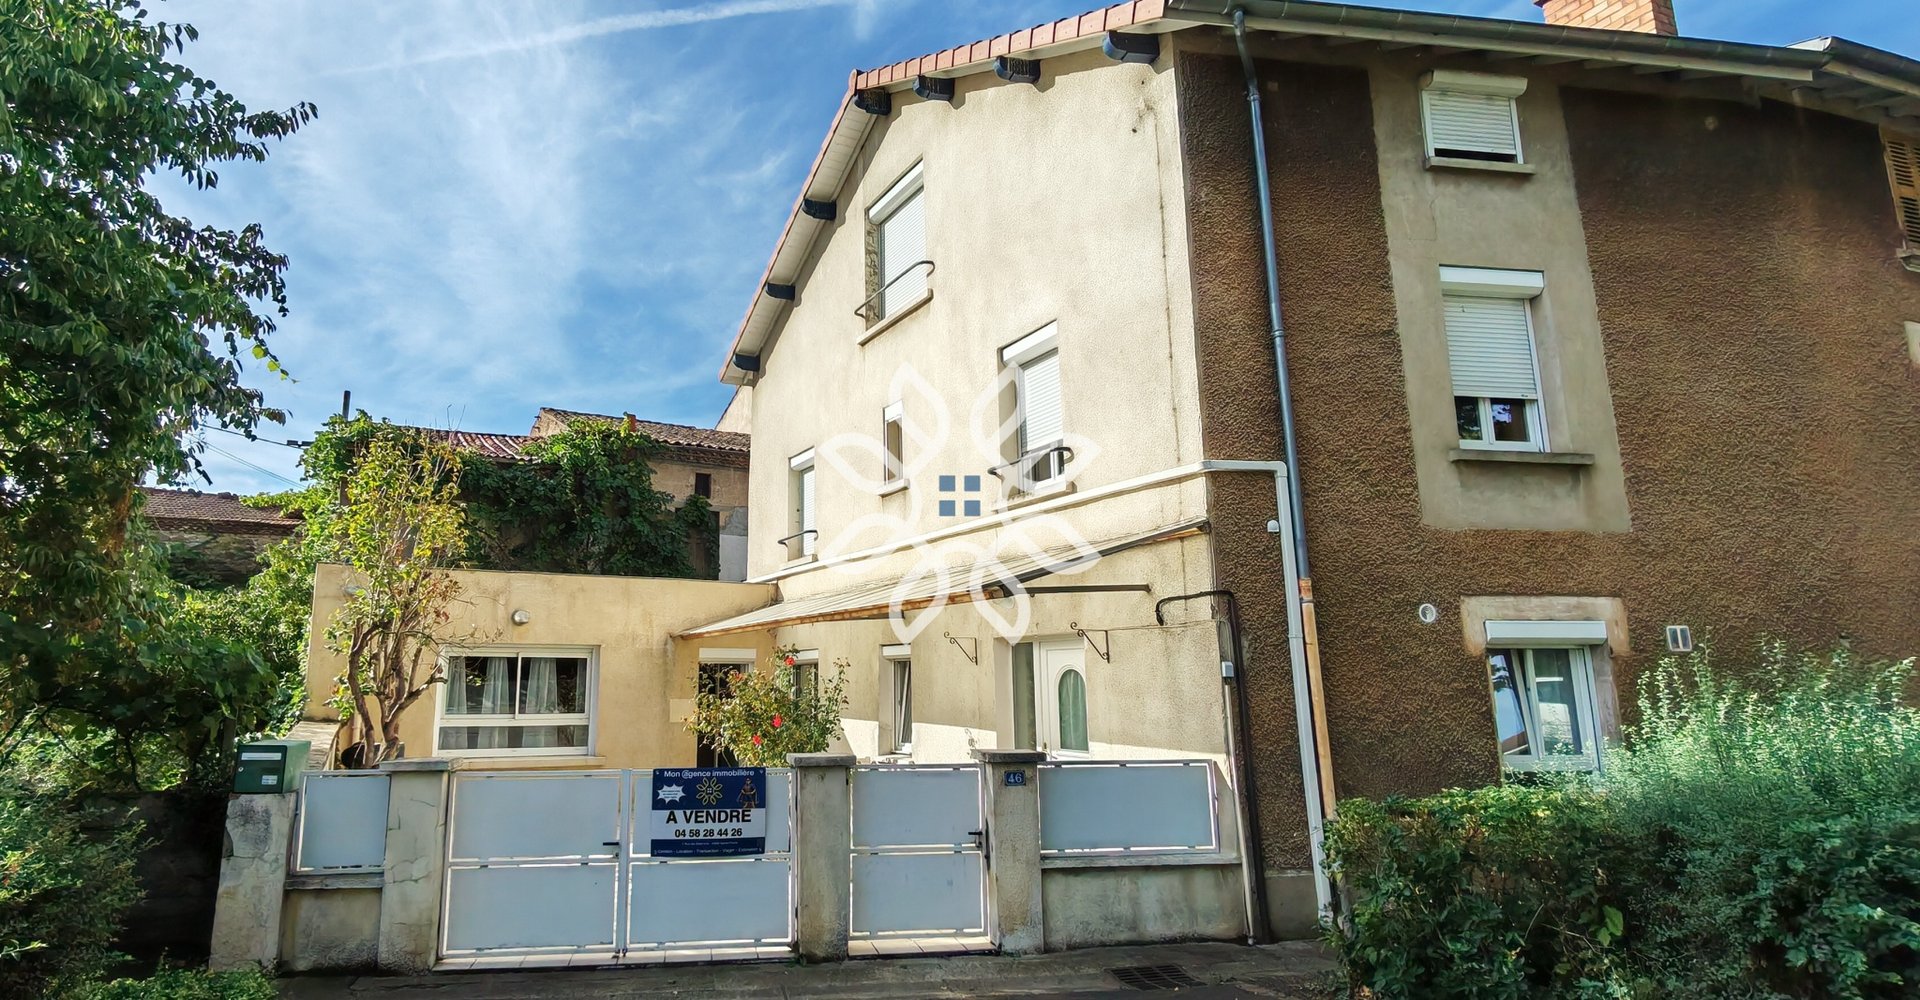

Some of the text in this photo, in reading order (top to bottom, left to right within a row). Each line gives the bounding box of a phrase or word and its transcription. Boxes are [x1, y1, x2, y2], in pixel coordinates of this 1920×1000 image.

[664, 770, 680, 778] Mon
[712, 769, 755, 777] immobilière
[1008, 773, 1022, 783] 46
[666, 809, 752, 824] A VENDRE
[674, 828, 743, 838] 04 58 28 44 26
